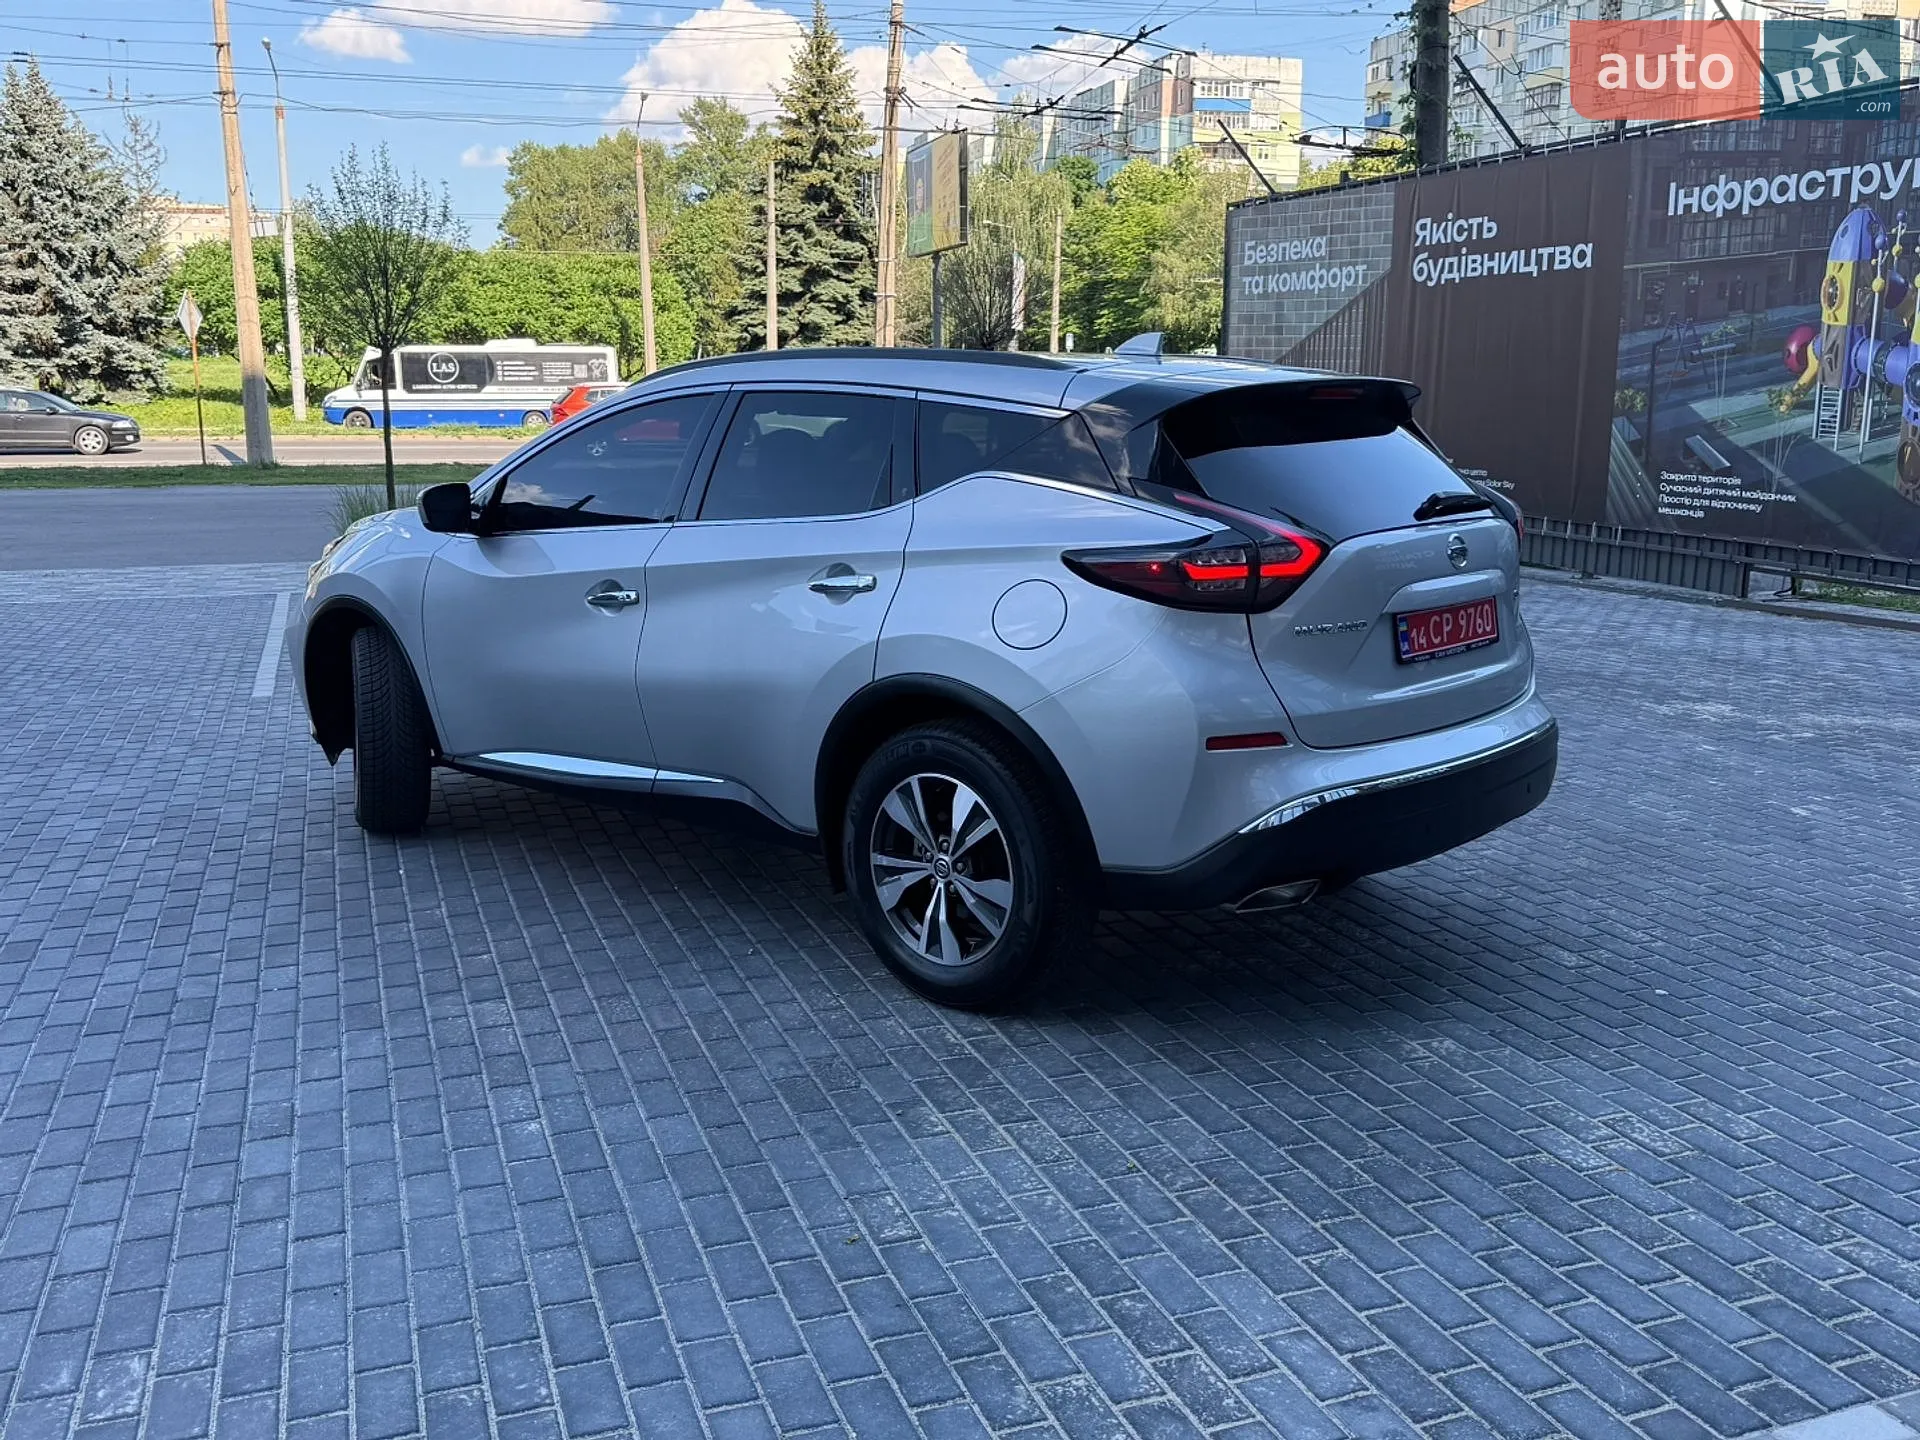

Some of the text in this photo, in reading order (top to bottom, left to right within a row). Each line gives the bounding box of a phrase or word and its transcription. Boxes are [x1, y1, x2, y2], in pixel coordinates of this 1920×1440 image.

[1414, 212, 1498, 247] Якість
[1243, 236, 1326, 265] Безпека
[1412, 243, 1593, 287] будівництва
[1242, 262, 1368, 295] та комфорт
[432, 362, 456, 373] LAS
[1659, 482, 1702, 495] Сучасний
[1660, 471, 1742, 485] Закрита територія
[1658, 493, 1692, 505] Простір
[1692, 497, 1710, 507] для
[1411, 626, 1427, 651] 14
[1429, 613, 1454, 644] CP
[1458, 603, 1492, 638] 9760
